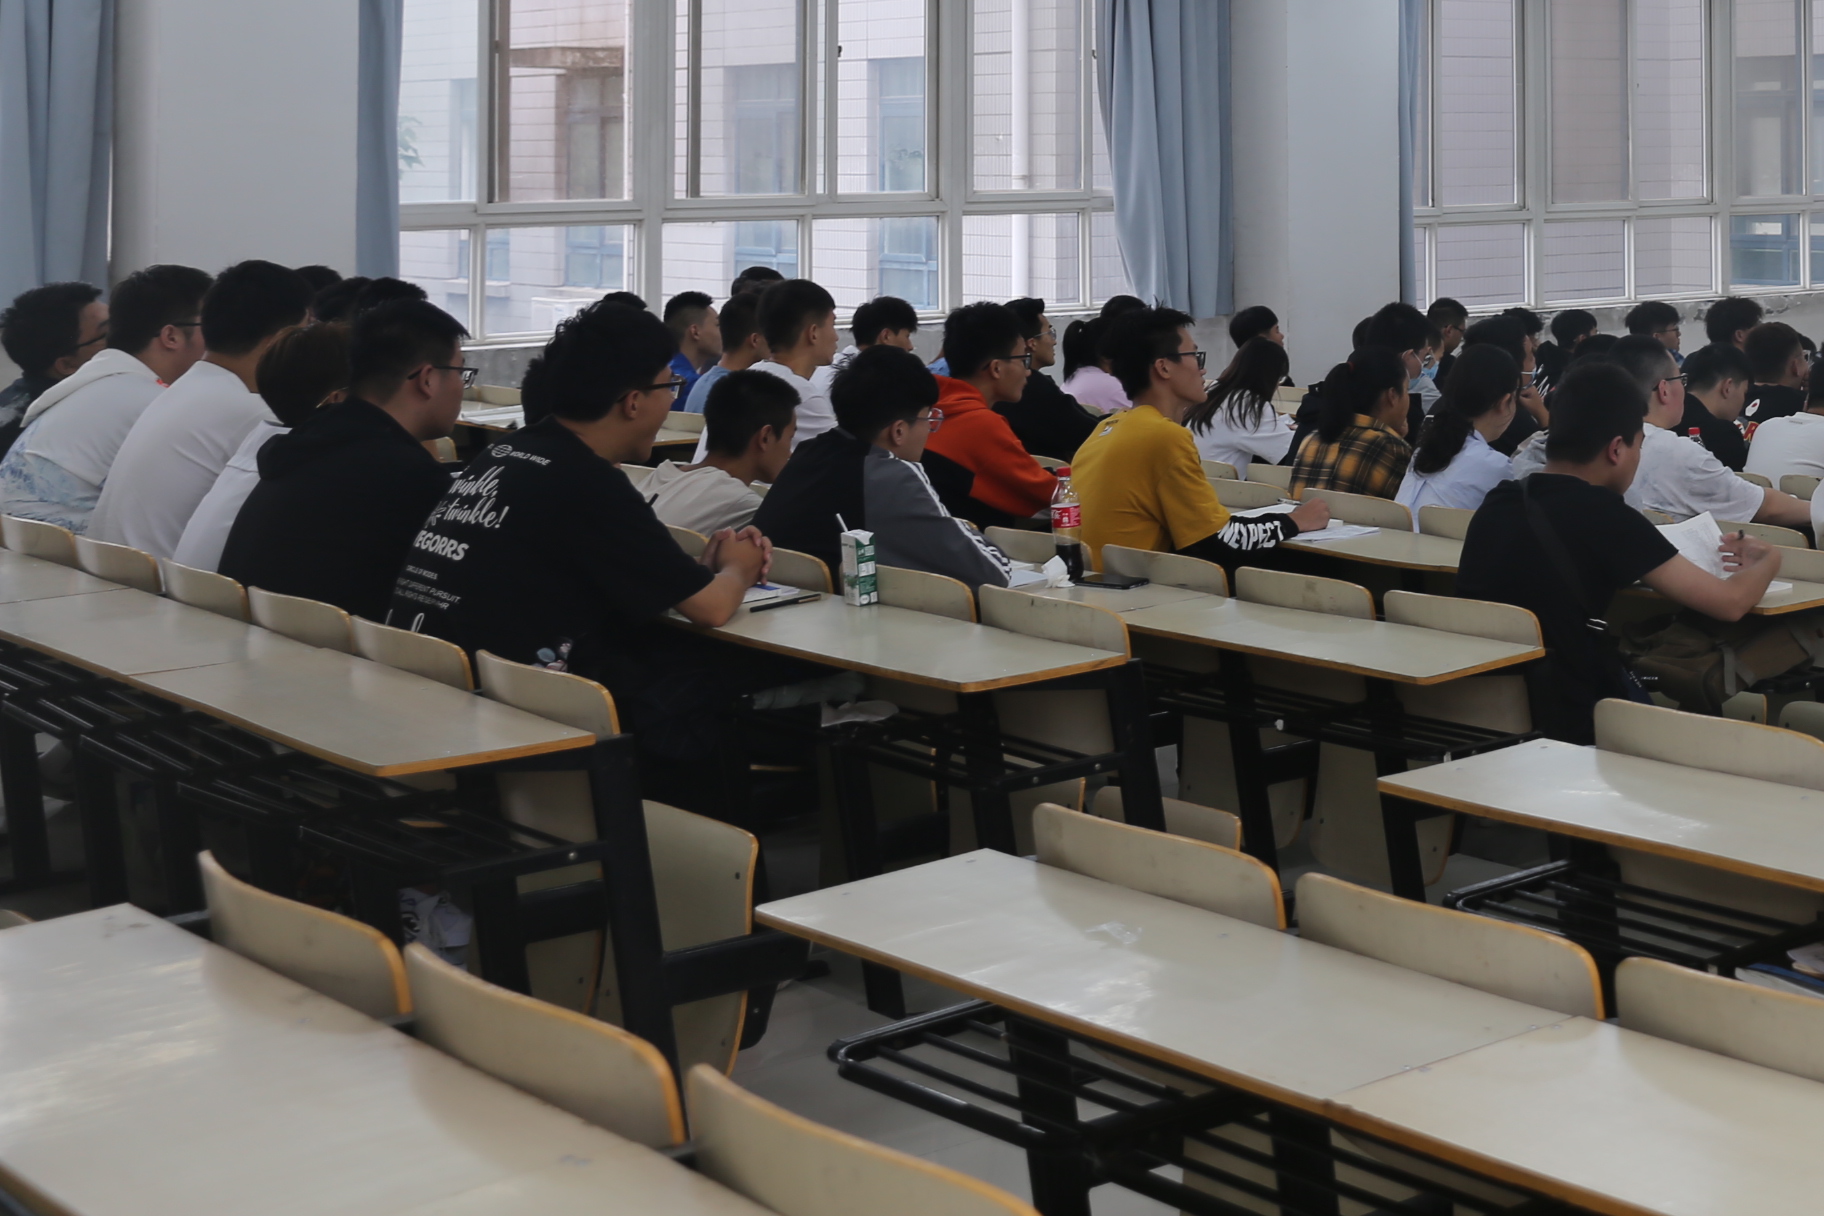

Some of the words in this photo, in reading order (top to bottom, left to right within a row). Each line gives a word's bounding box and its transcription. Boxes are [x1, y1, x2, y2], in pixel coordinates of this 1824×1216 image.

[510, 450, 531, 460] WORLD
[529, 454, 552, 466] WIDE
[449, 465, 506, 498] winkle,
[443, 496, 510, 529] twinkle!
[412, 529, 470, 561] EGORRS
[1217, 520, 1284, 551] NEXPECT
